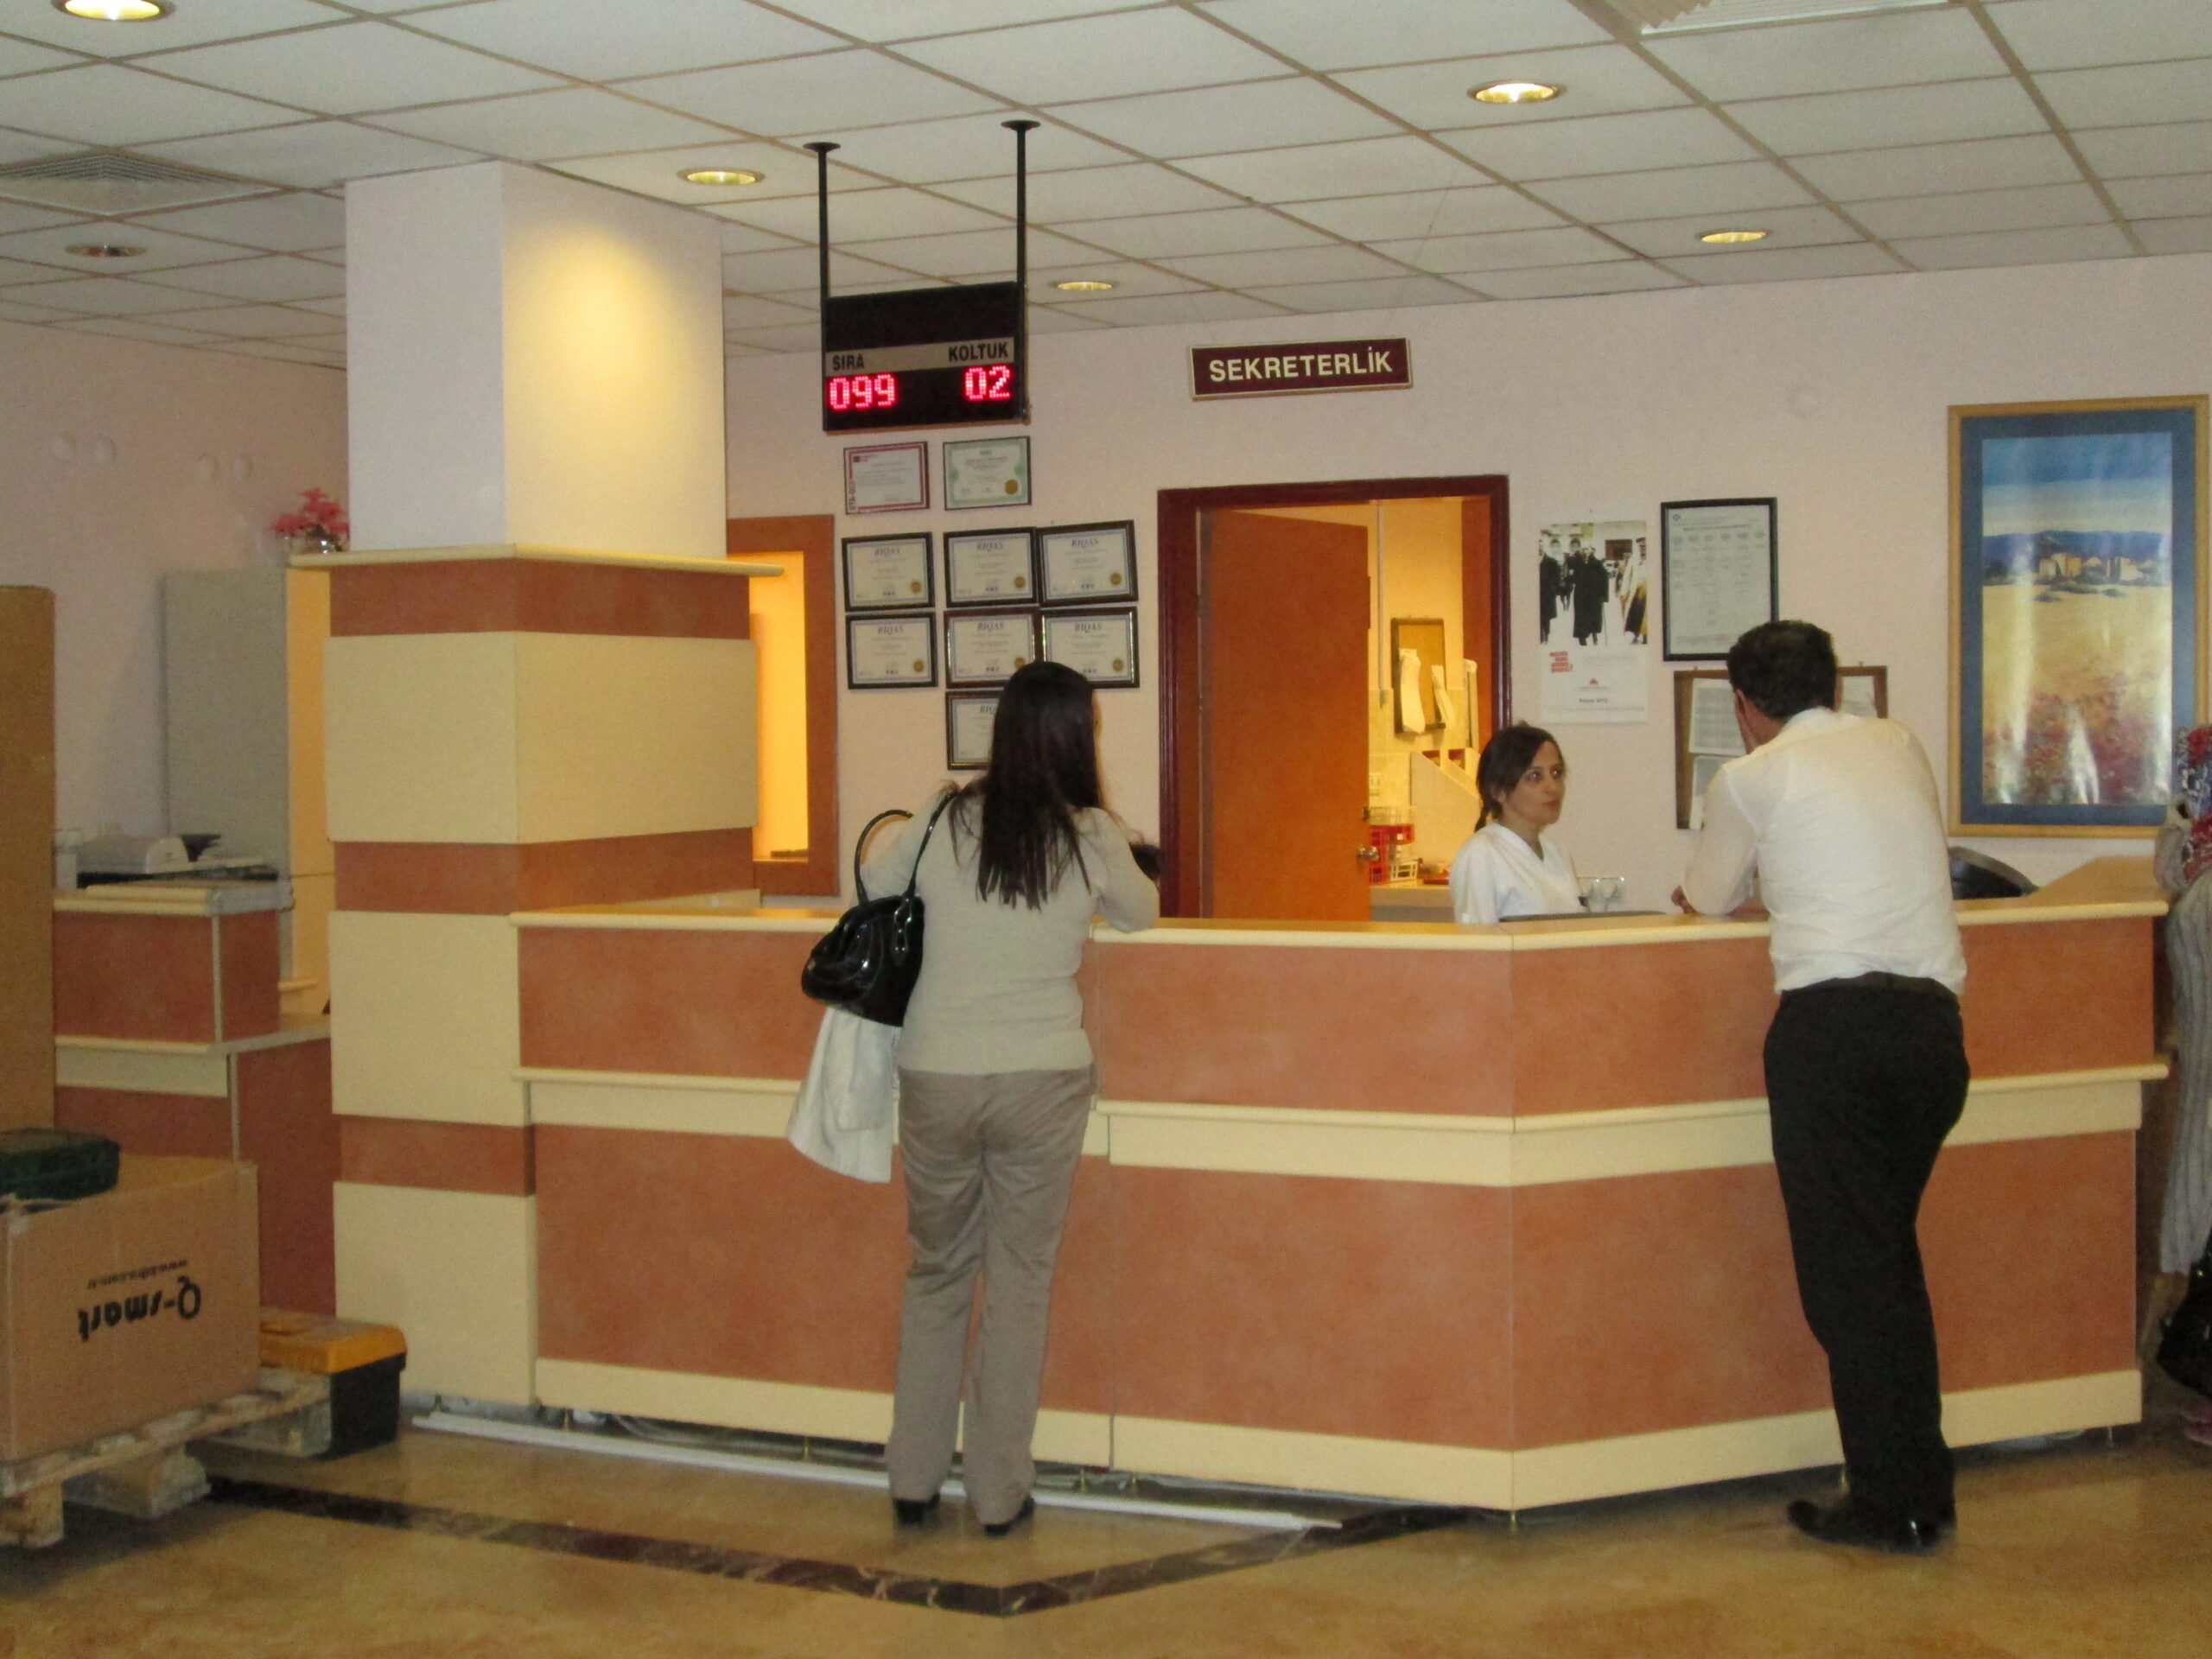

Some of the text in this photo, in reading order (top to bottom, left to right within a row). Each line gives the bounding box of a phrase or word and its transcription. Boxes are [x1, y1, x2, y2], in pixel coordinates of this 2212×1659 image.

[948, 341, 1008, 362] KOLTUK
[832, 354, 865, 372] SIRA
[1209, 346, 1393, 383] SEKRETERLİK
[829, 372, 896, 410] 099
[964, 365, 1011, 402] 02
[1071, 537, 1098, 549] RIQAS
[977, 621, 1004, 632] RIQAS
[1074, 622, 1102, 632] RIQAS
[78, 1274, 201, 1343] Q-smart
